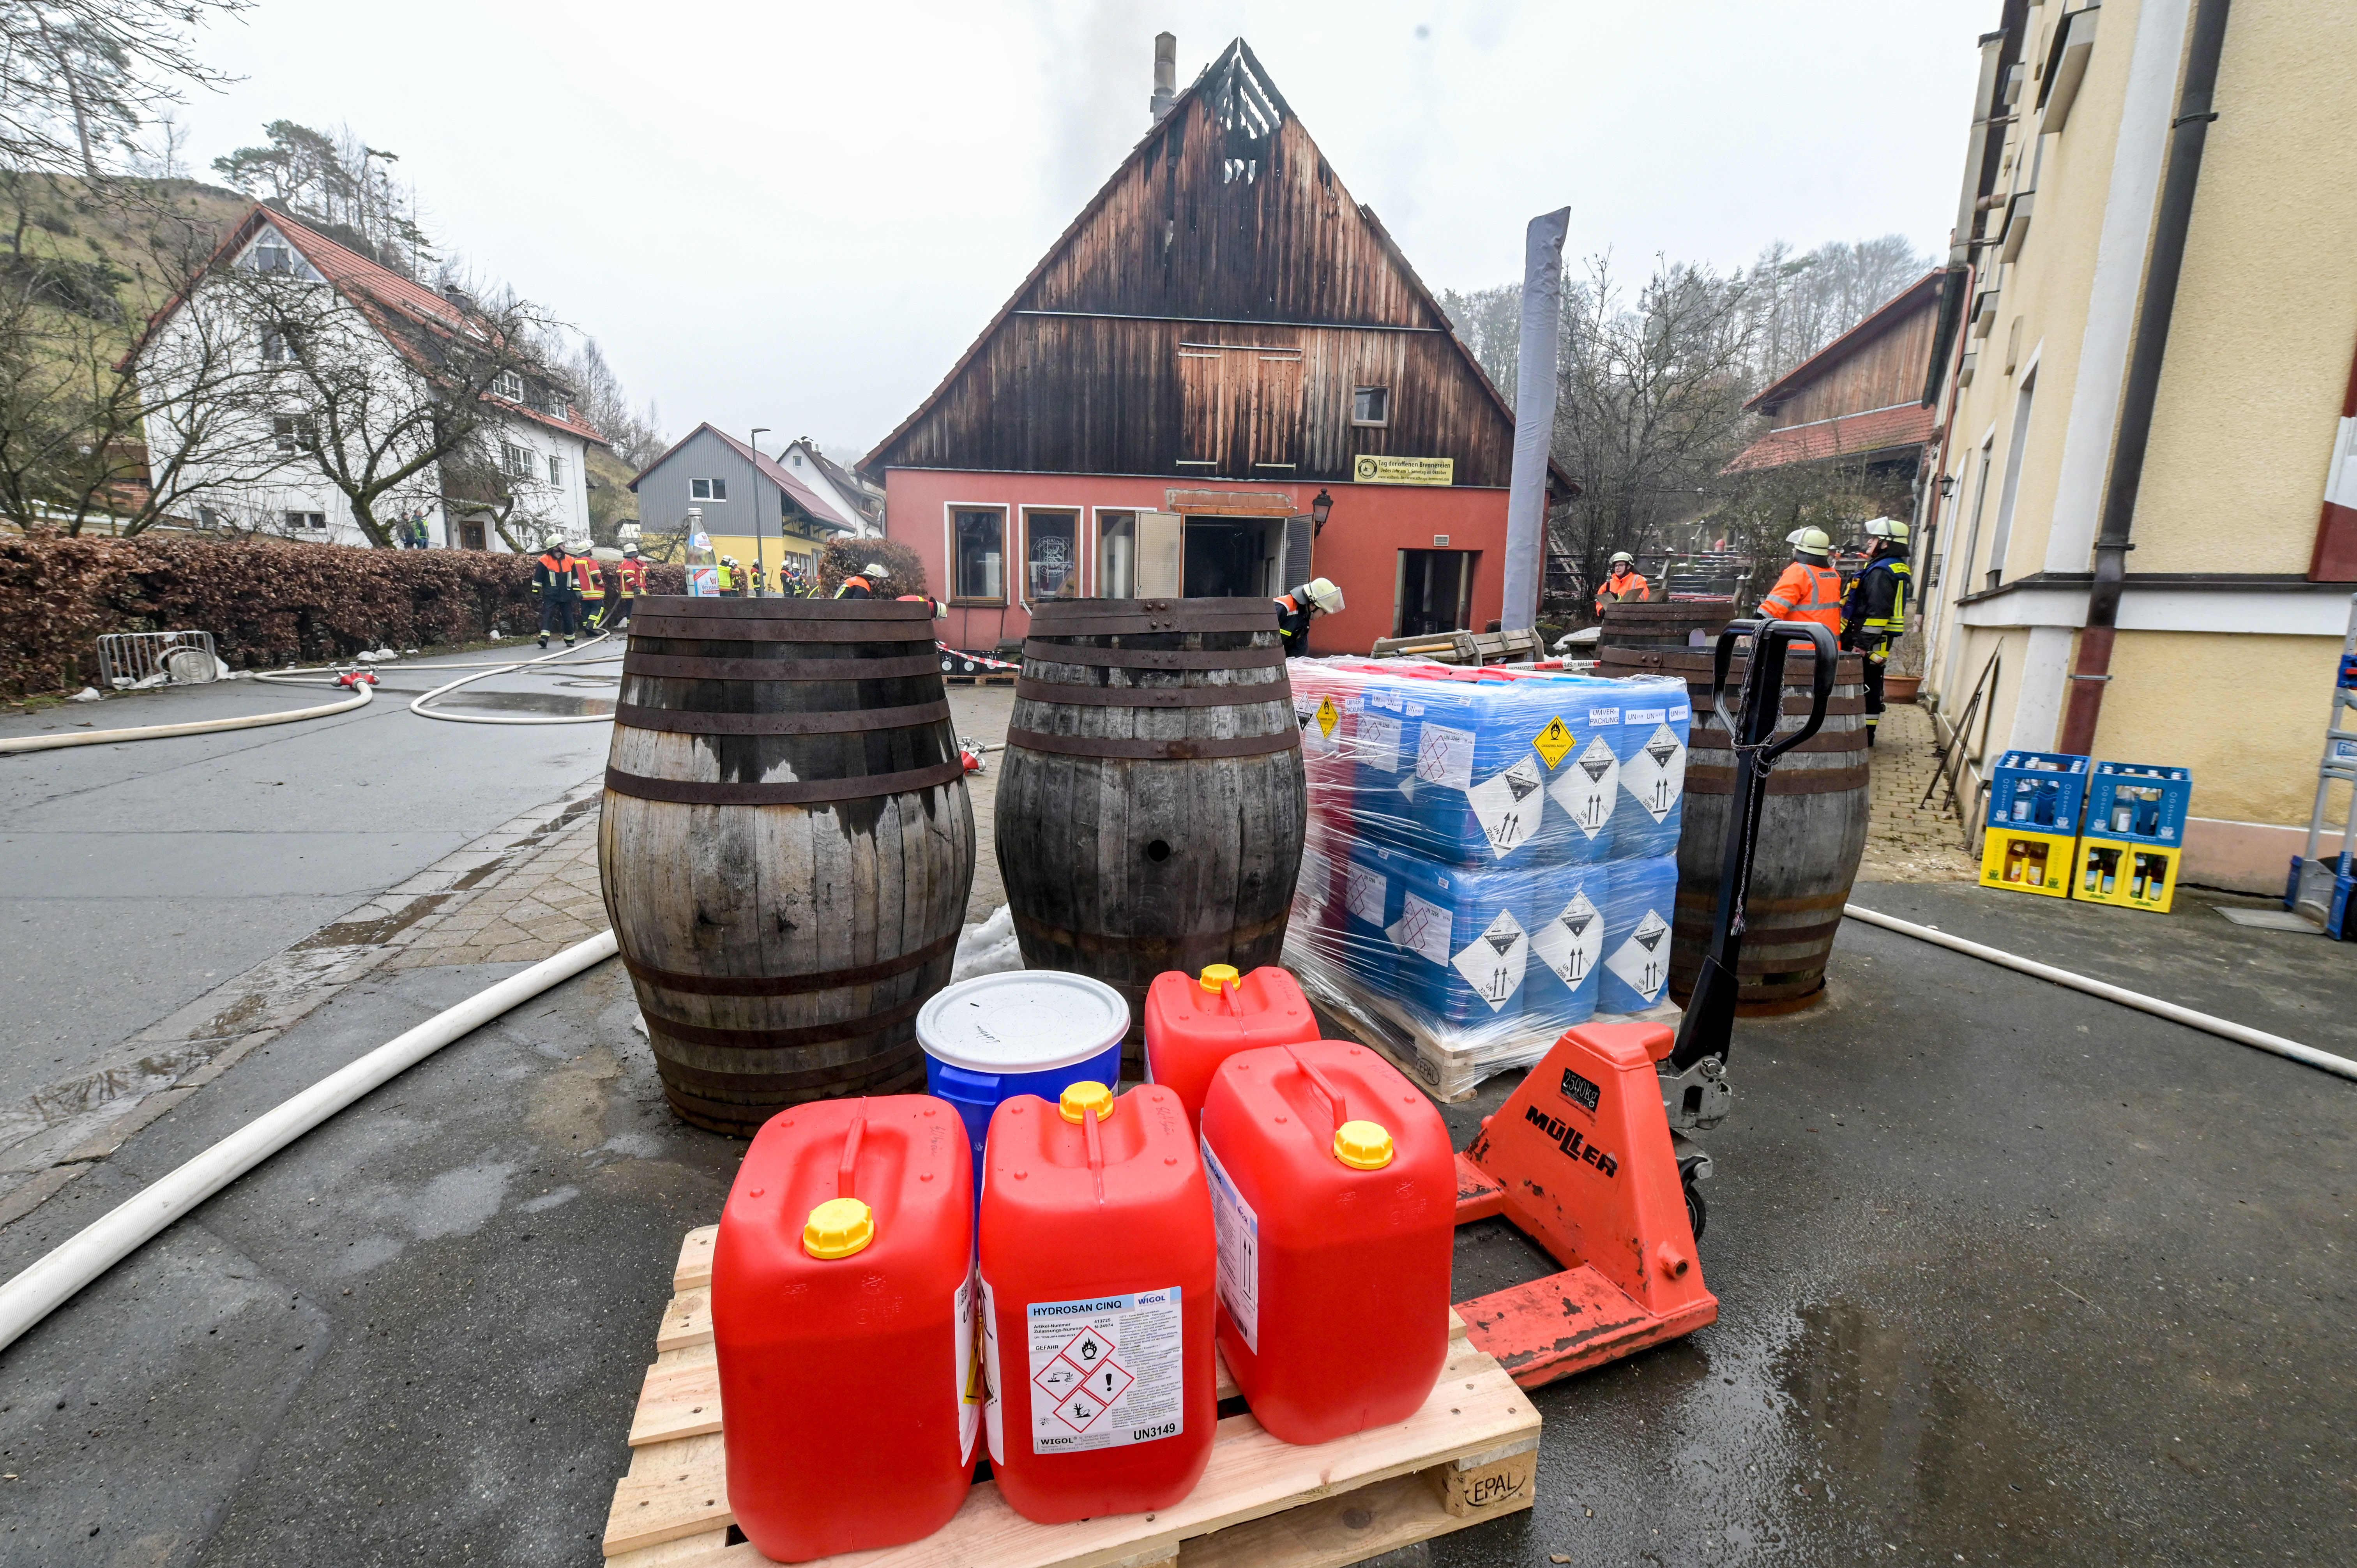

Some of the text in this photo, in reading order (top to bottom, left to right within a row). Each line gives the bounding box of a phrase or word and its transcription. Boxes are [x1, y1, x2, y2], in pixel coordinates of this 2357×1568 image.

[1509, 777, 1534, 788] CORROSIVE
[1643, 799, 1652, 810] 3266
[1649, 795, 1656, 803] UN
[1574, 814, 1584, 826] 3266
[1581, 810, 1588, 819] UN
[1486, 827, 1495, 841] 3266
[1493, 825, 1500, 835] UN
[1639, 930, 1662, 940] CORROSIVE
[1556, 967, 1567, 979] 3266
[1563, 963, 1570, 972] UN
[1479, 987, 1489, 999] 3266
[1486, 983, 1493, 992] UN
[1633, 982, 1643, 992] 3266
[1420, 1061, 1436, 1082] EPAL
[1563, 1072, 1598, 1107] 2500kg
[1525, 1105, 1618, 1178] MÜLLER
[1237, 1206, 1248, 1225] WIGOL
[1138, 1295, 1166, 1305] WIGOL
[1034, 1300, 1122, 1316] HYDROSAN CINQ
[1134, 1423, 1175, 1441] UN3149
[1475, 1471, 1517, 1503] EPAL
